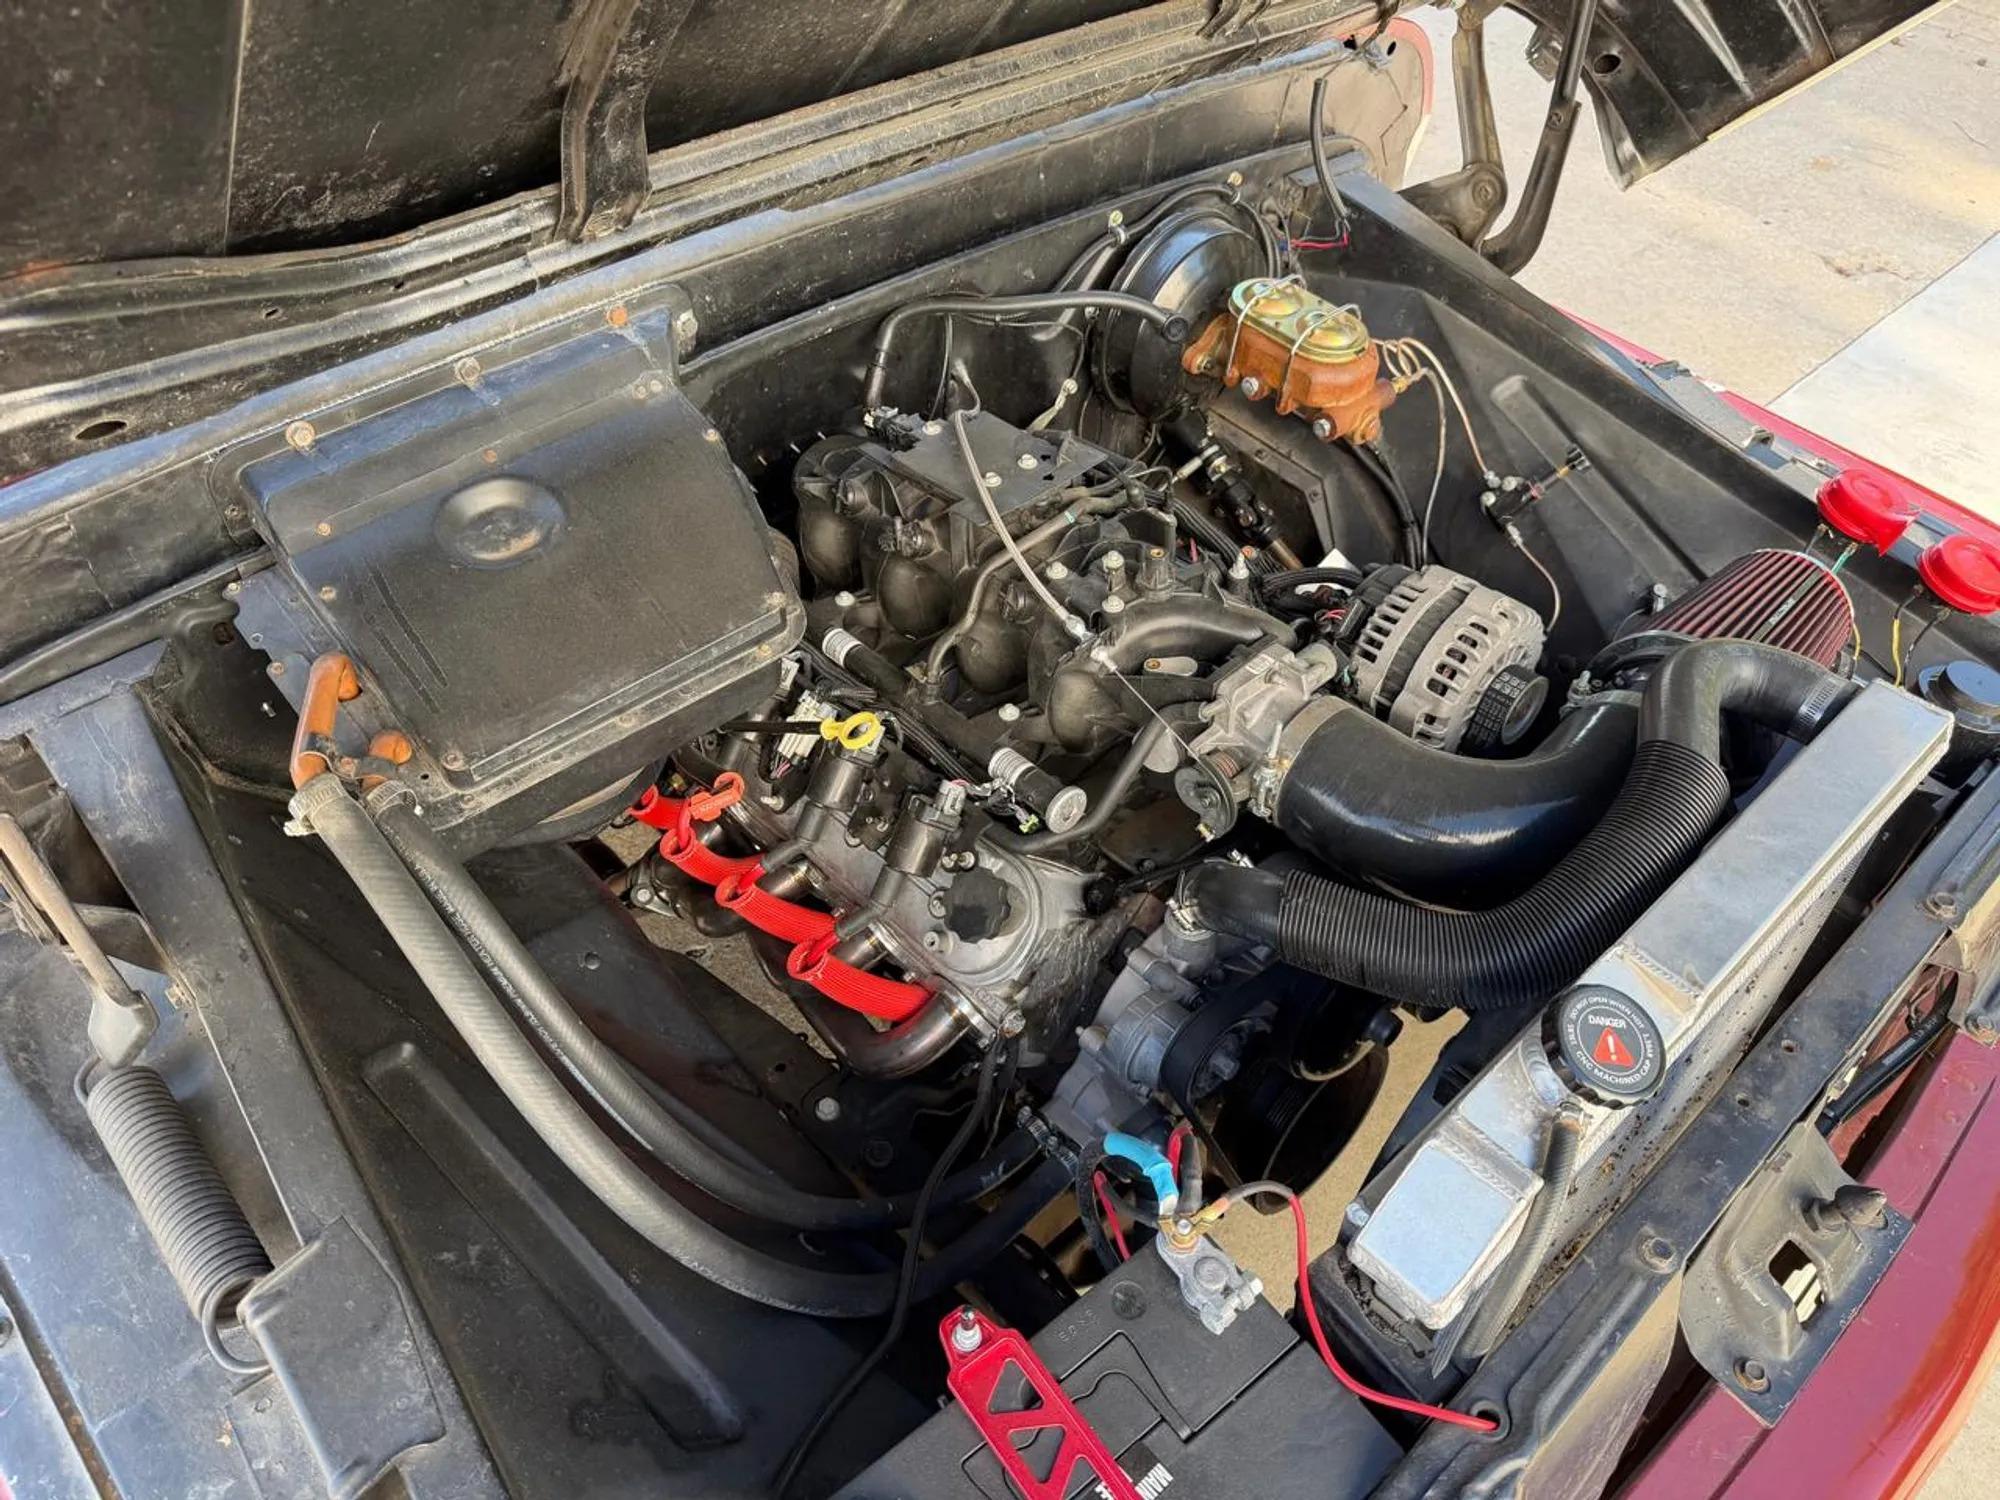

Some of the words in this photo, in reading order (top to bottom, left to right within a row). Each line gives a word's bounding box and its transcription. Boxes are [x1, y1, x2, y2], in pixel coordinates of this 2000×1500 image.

[1588, 1015, 1626, 1028] DANGER
[1576, 1050, 1593, 1070] CNC
[1593, 1068, 1640, 1084] MACHINED
[1640, 1059, 1651, 1076] CAP
